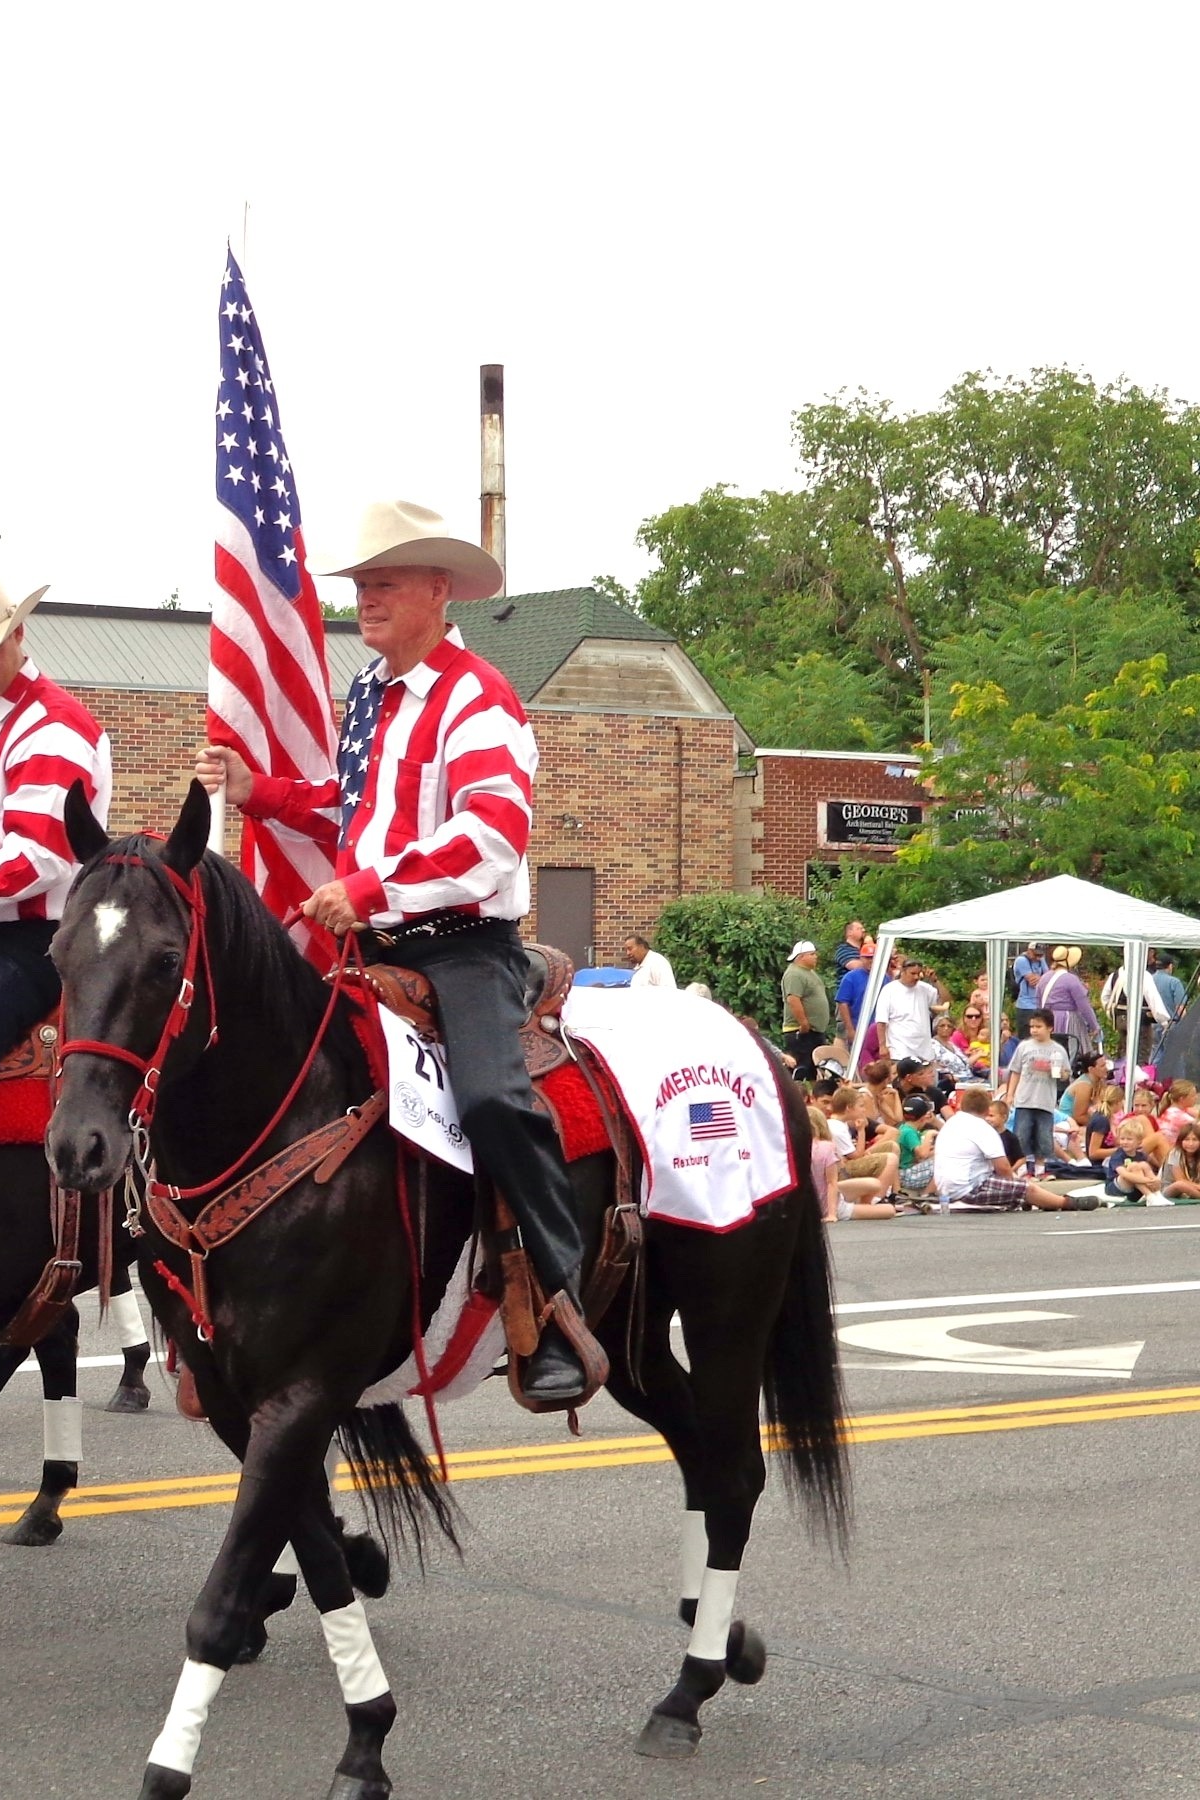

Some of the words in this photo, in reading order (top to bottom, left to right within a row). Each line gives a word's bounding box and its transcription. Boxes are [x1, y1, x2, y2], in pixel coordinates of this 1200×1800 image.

[842, 804, 908, 824] GEORGE'S
[656, 1064, 756, 1110] AMERICANAS
[673, 1155, 709, 1169] Rexburg
